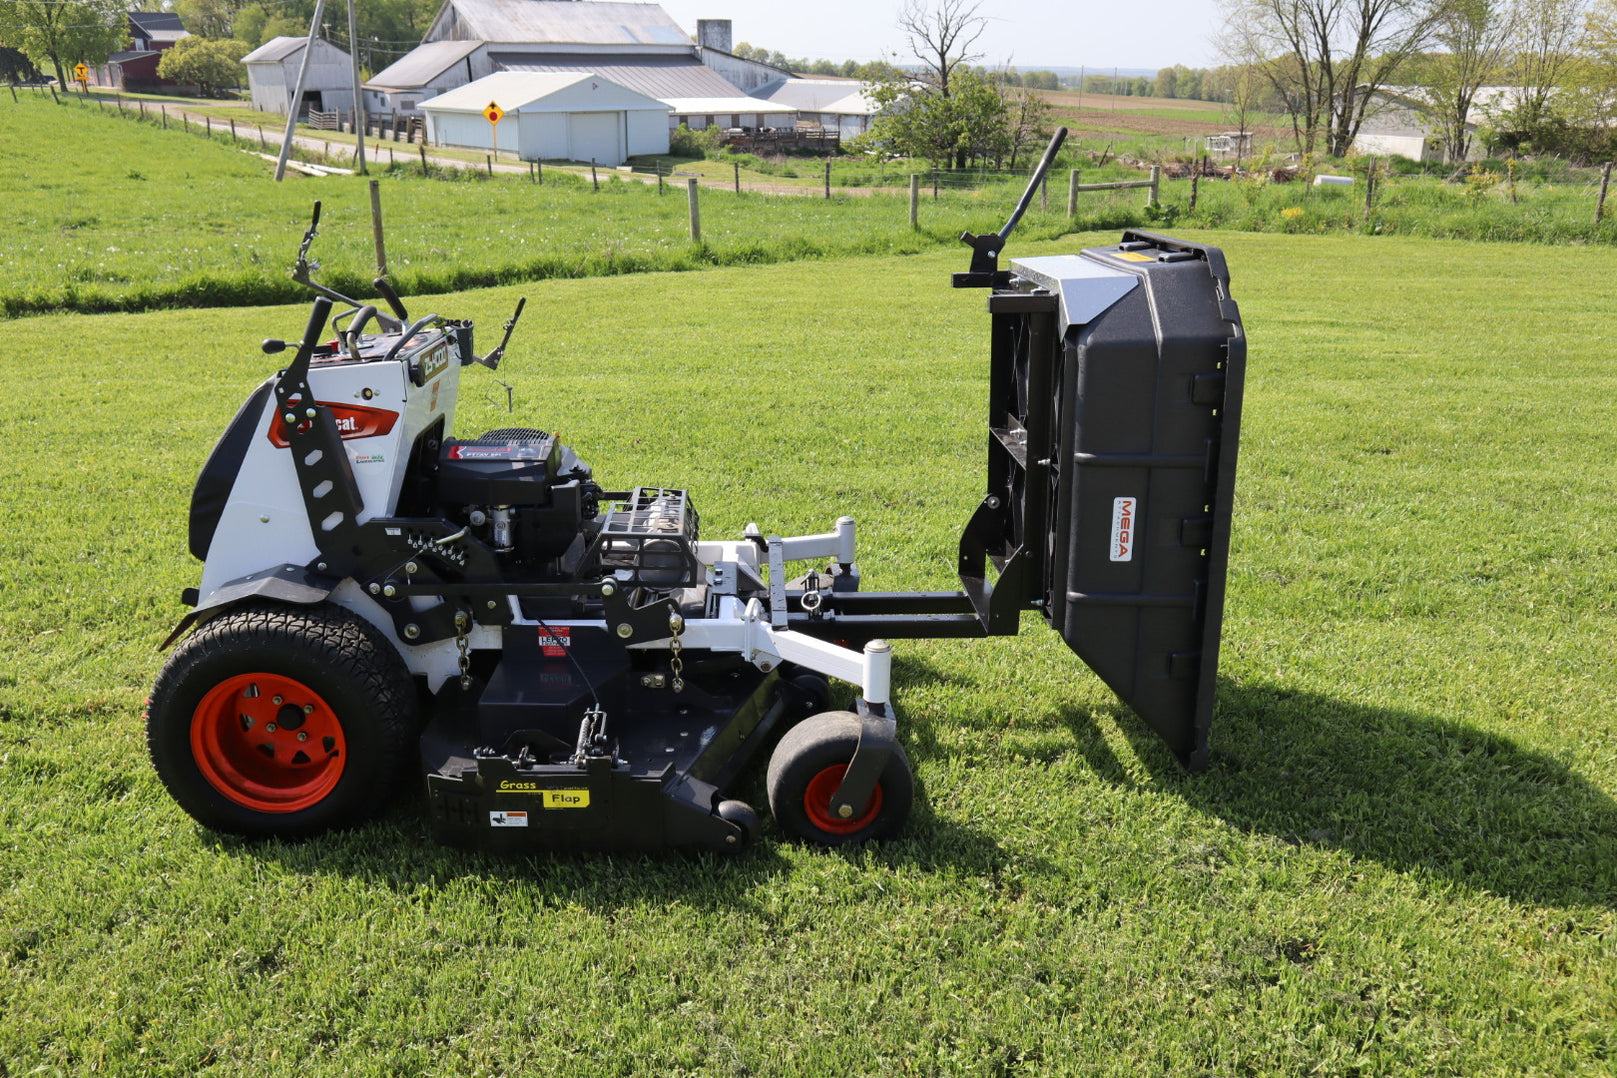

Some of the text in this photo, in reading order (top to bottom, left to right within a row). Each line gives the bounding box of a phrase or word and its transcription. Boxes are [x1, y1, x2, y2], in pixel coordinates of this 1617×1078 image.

[1118, 500, 1132, 558] MEGA
[500, 780, 537, 790] Grass
[552, 794, 581, 804] Flap
